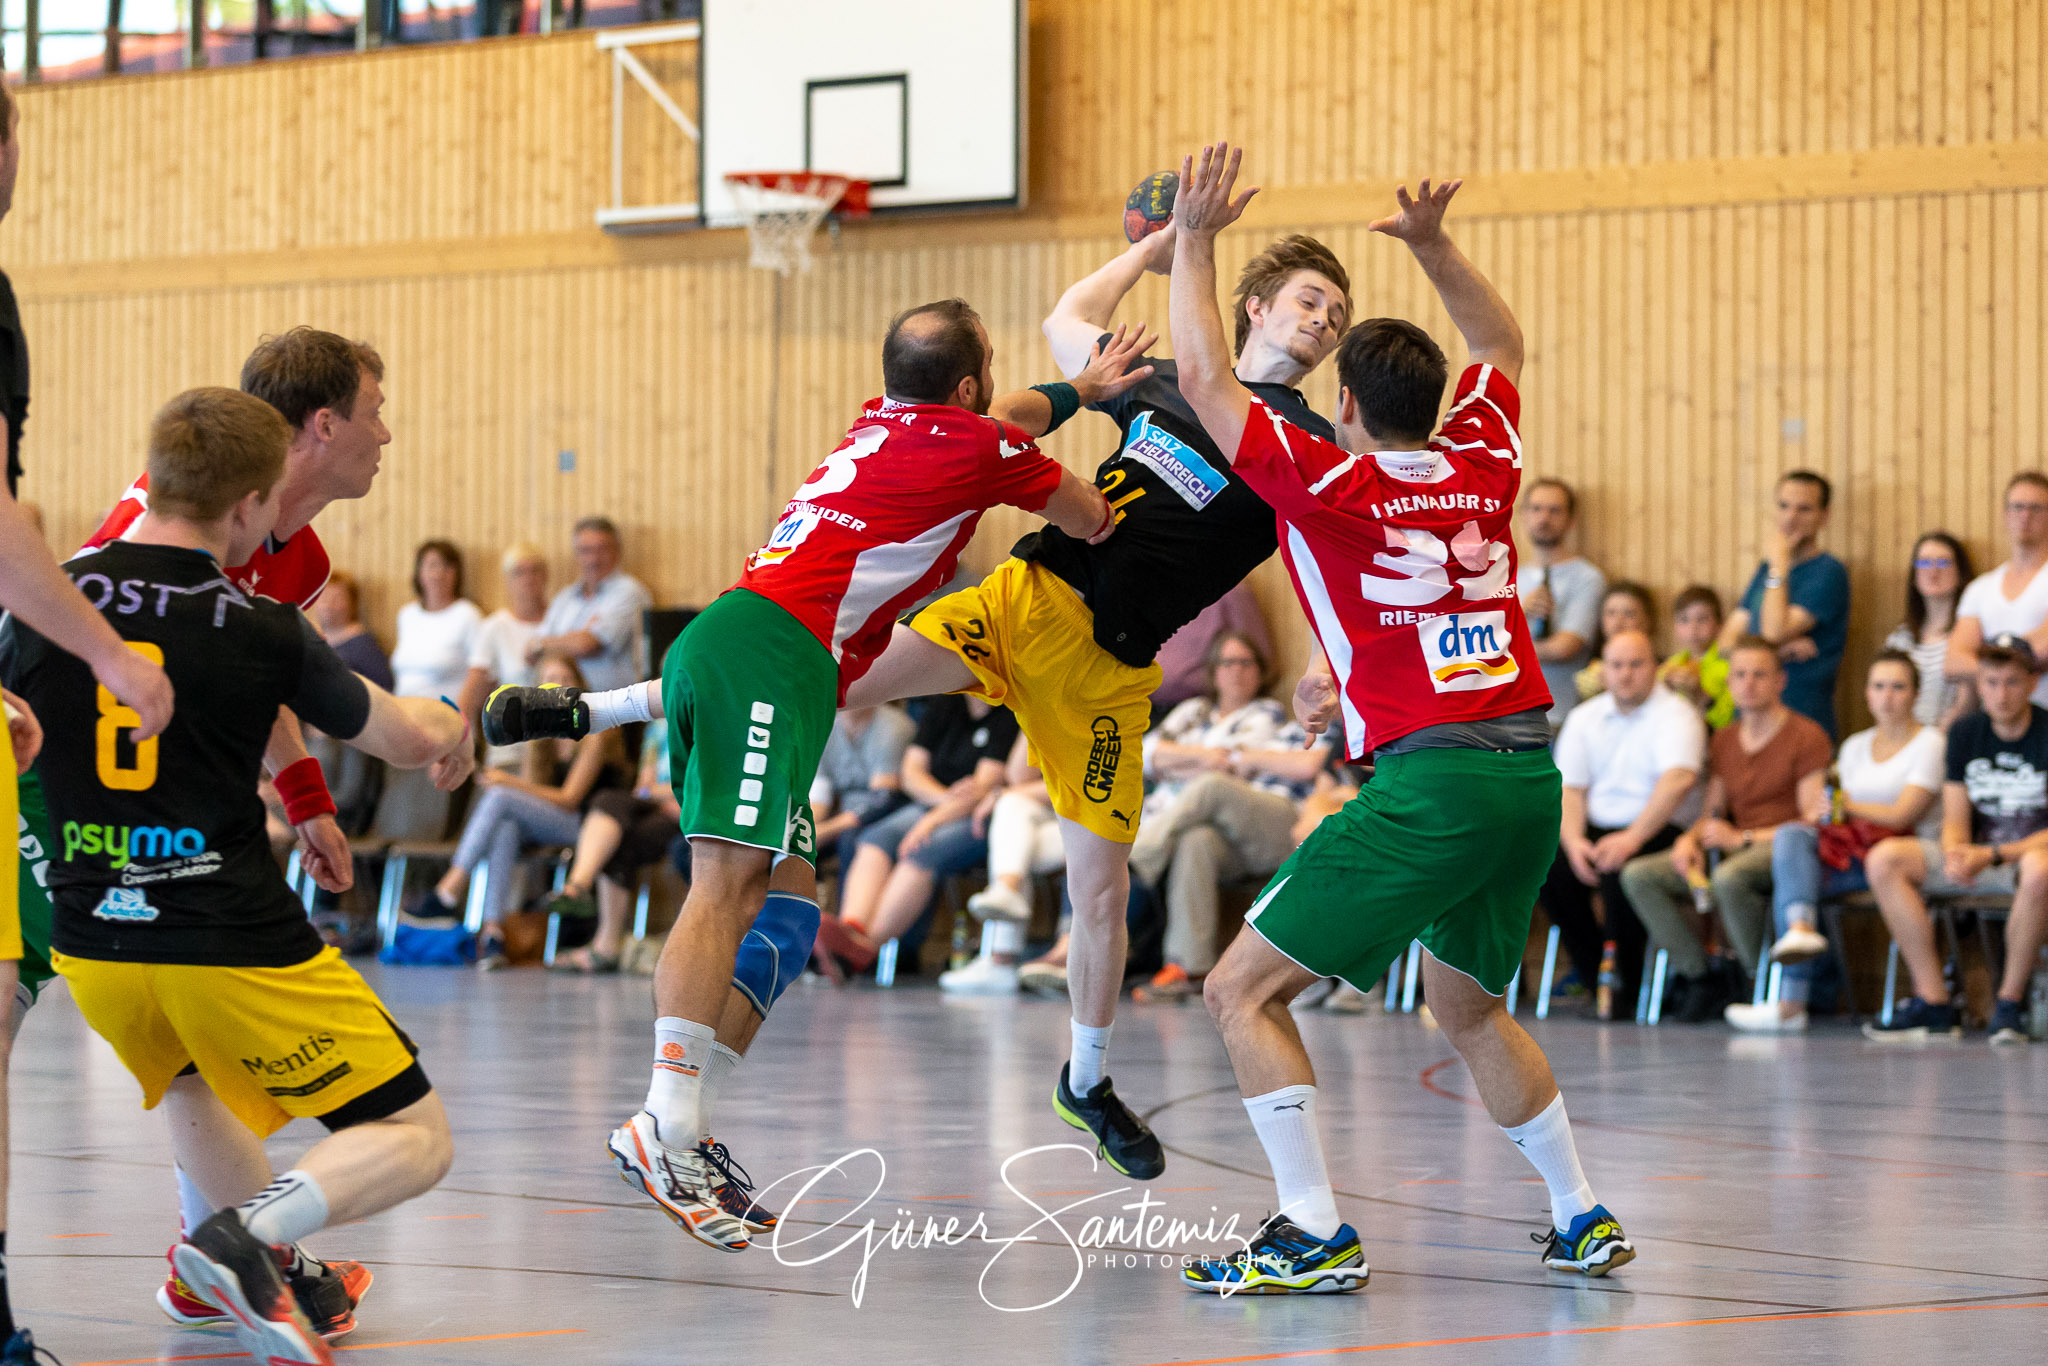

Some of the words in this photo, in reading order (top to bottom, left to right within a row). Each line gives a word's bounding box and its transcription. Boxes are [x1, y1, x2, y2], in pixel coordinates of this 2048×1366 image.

[1147, 430, 1182, 455] SALZ
[1137, 440, 1212, 501] HELMREICH
[1360, 520, 1511, 607] 39
[1438, 614, 1500, 659] dm
[96, 641, 165, 791] 8
[241, 1032, 336, 1076] Mentis
